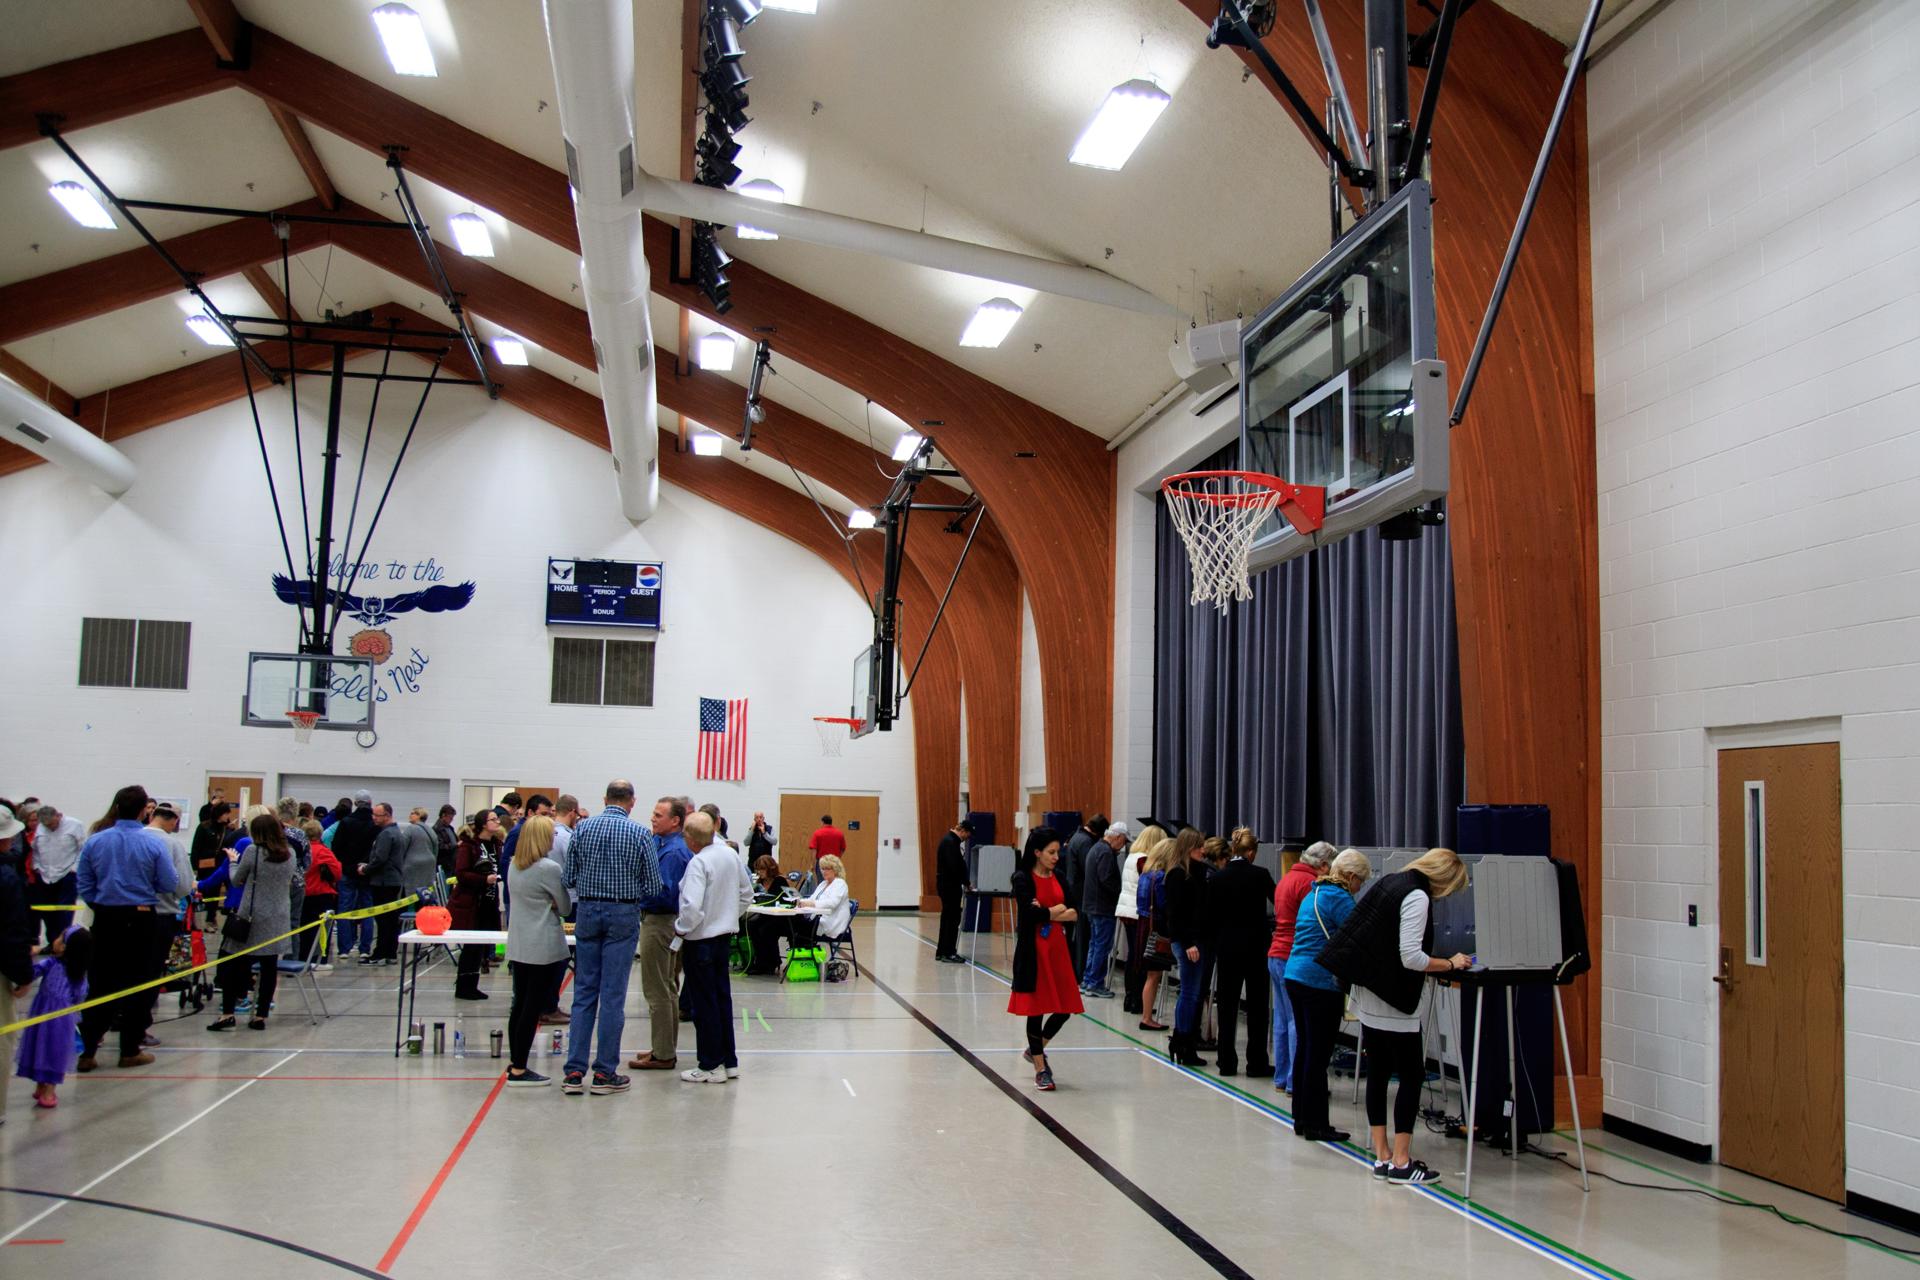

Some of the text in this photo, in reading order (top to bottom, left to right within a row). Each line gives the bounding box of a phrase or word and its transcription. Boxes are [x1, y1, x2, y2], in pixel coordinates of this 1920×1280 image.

[386, 559, 408, 580] to
[412, 557, 445, 581] the
[554, 584, 578, 592] HOME
[630, 588, 655, 596] GUEST
[329, 670, 388, 702] gle's
